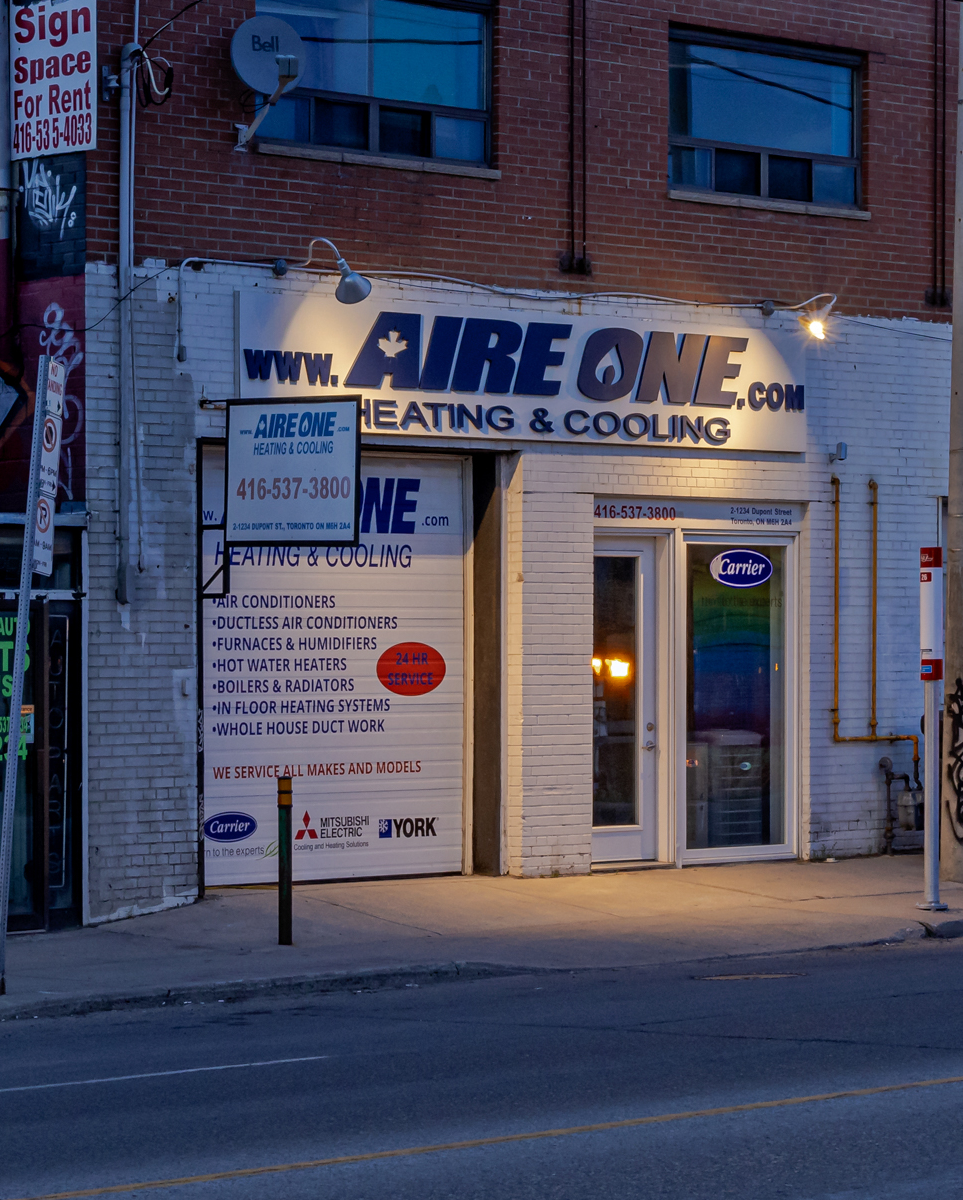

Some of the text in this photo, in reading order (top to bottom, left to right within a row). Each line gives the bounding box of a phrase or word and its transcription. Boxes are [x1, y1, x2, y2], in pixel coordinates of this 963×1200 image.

[14, 5, 91, 48] Sign
[251, 34, 279, 52] Bell
[14, 50, 91, 85] Space
[14, 79, 92, 120] For Rent
[529, 407, 555, 433] &
[563, 409, 731, 443] COOLING
[253, 440, 334, 455] HEATING & COOLING
[236, 476, 351, 500] 416-537-3800
[594, 504, 676, 520] 416-537-3800
[730, 507, 792, 517] 2-1234 Dupont Street
[232, 522, 251, 530] 2-1234
[251, 522, 274, 530] DUPONT
[287, 522, 314, 530] TORONTO
[315, 522, 325, 530] ON
[421, 514, 450, 527] .com
[731, 517, 754, 526] Toronto,
[780, 517, 792, 525] 2A4
[307, 546, 319, 567] &
[325, 543, 413, 568] COOLING
[718, 558, 766, 576] Carrier
[217, 595, 336, 609] AIR CONDITIONERS
[217, 616, 398, 629] DUCTLESS AIR CONDITIONERS
[217, 637, 377, 651] FURNACES & HUMIDIFIERS
[217, 658, 347, 672] HOT WATER HEATERS
[396, 652, 429, 665] 24 HR
[217, 678, 355, 693] BOILERS & RADIATORS
[387, 672, 434, 686] SERVICE
[217, 698, 391, 715] IN FLOOR HEATING SYSTEMS
[216, 719, 385, 736] WHOLE HOUSE DUCT WORK
[212, 760, 422, 780] WE SERVICE ALL MAKES AND MODELS
[209, 819, 251, 834] Carrier
[320, 816, 437, 838] MITSUBISHI YORK
[320, 827, 363, 839] ELECTRIC
[212, 848, 220, 857] to
[222, 847, 234, 856] the
[235, 845, 265, 857] experts
[293, 843, 314, 851] Cooling
[325, 841, 345, 850] Heating
[346, 840, 369, 848] Solutions
